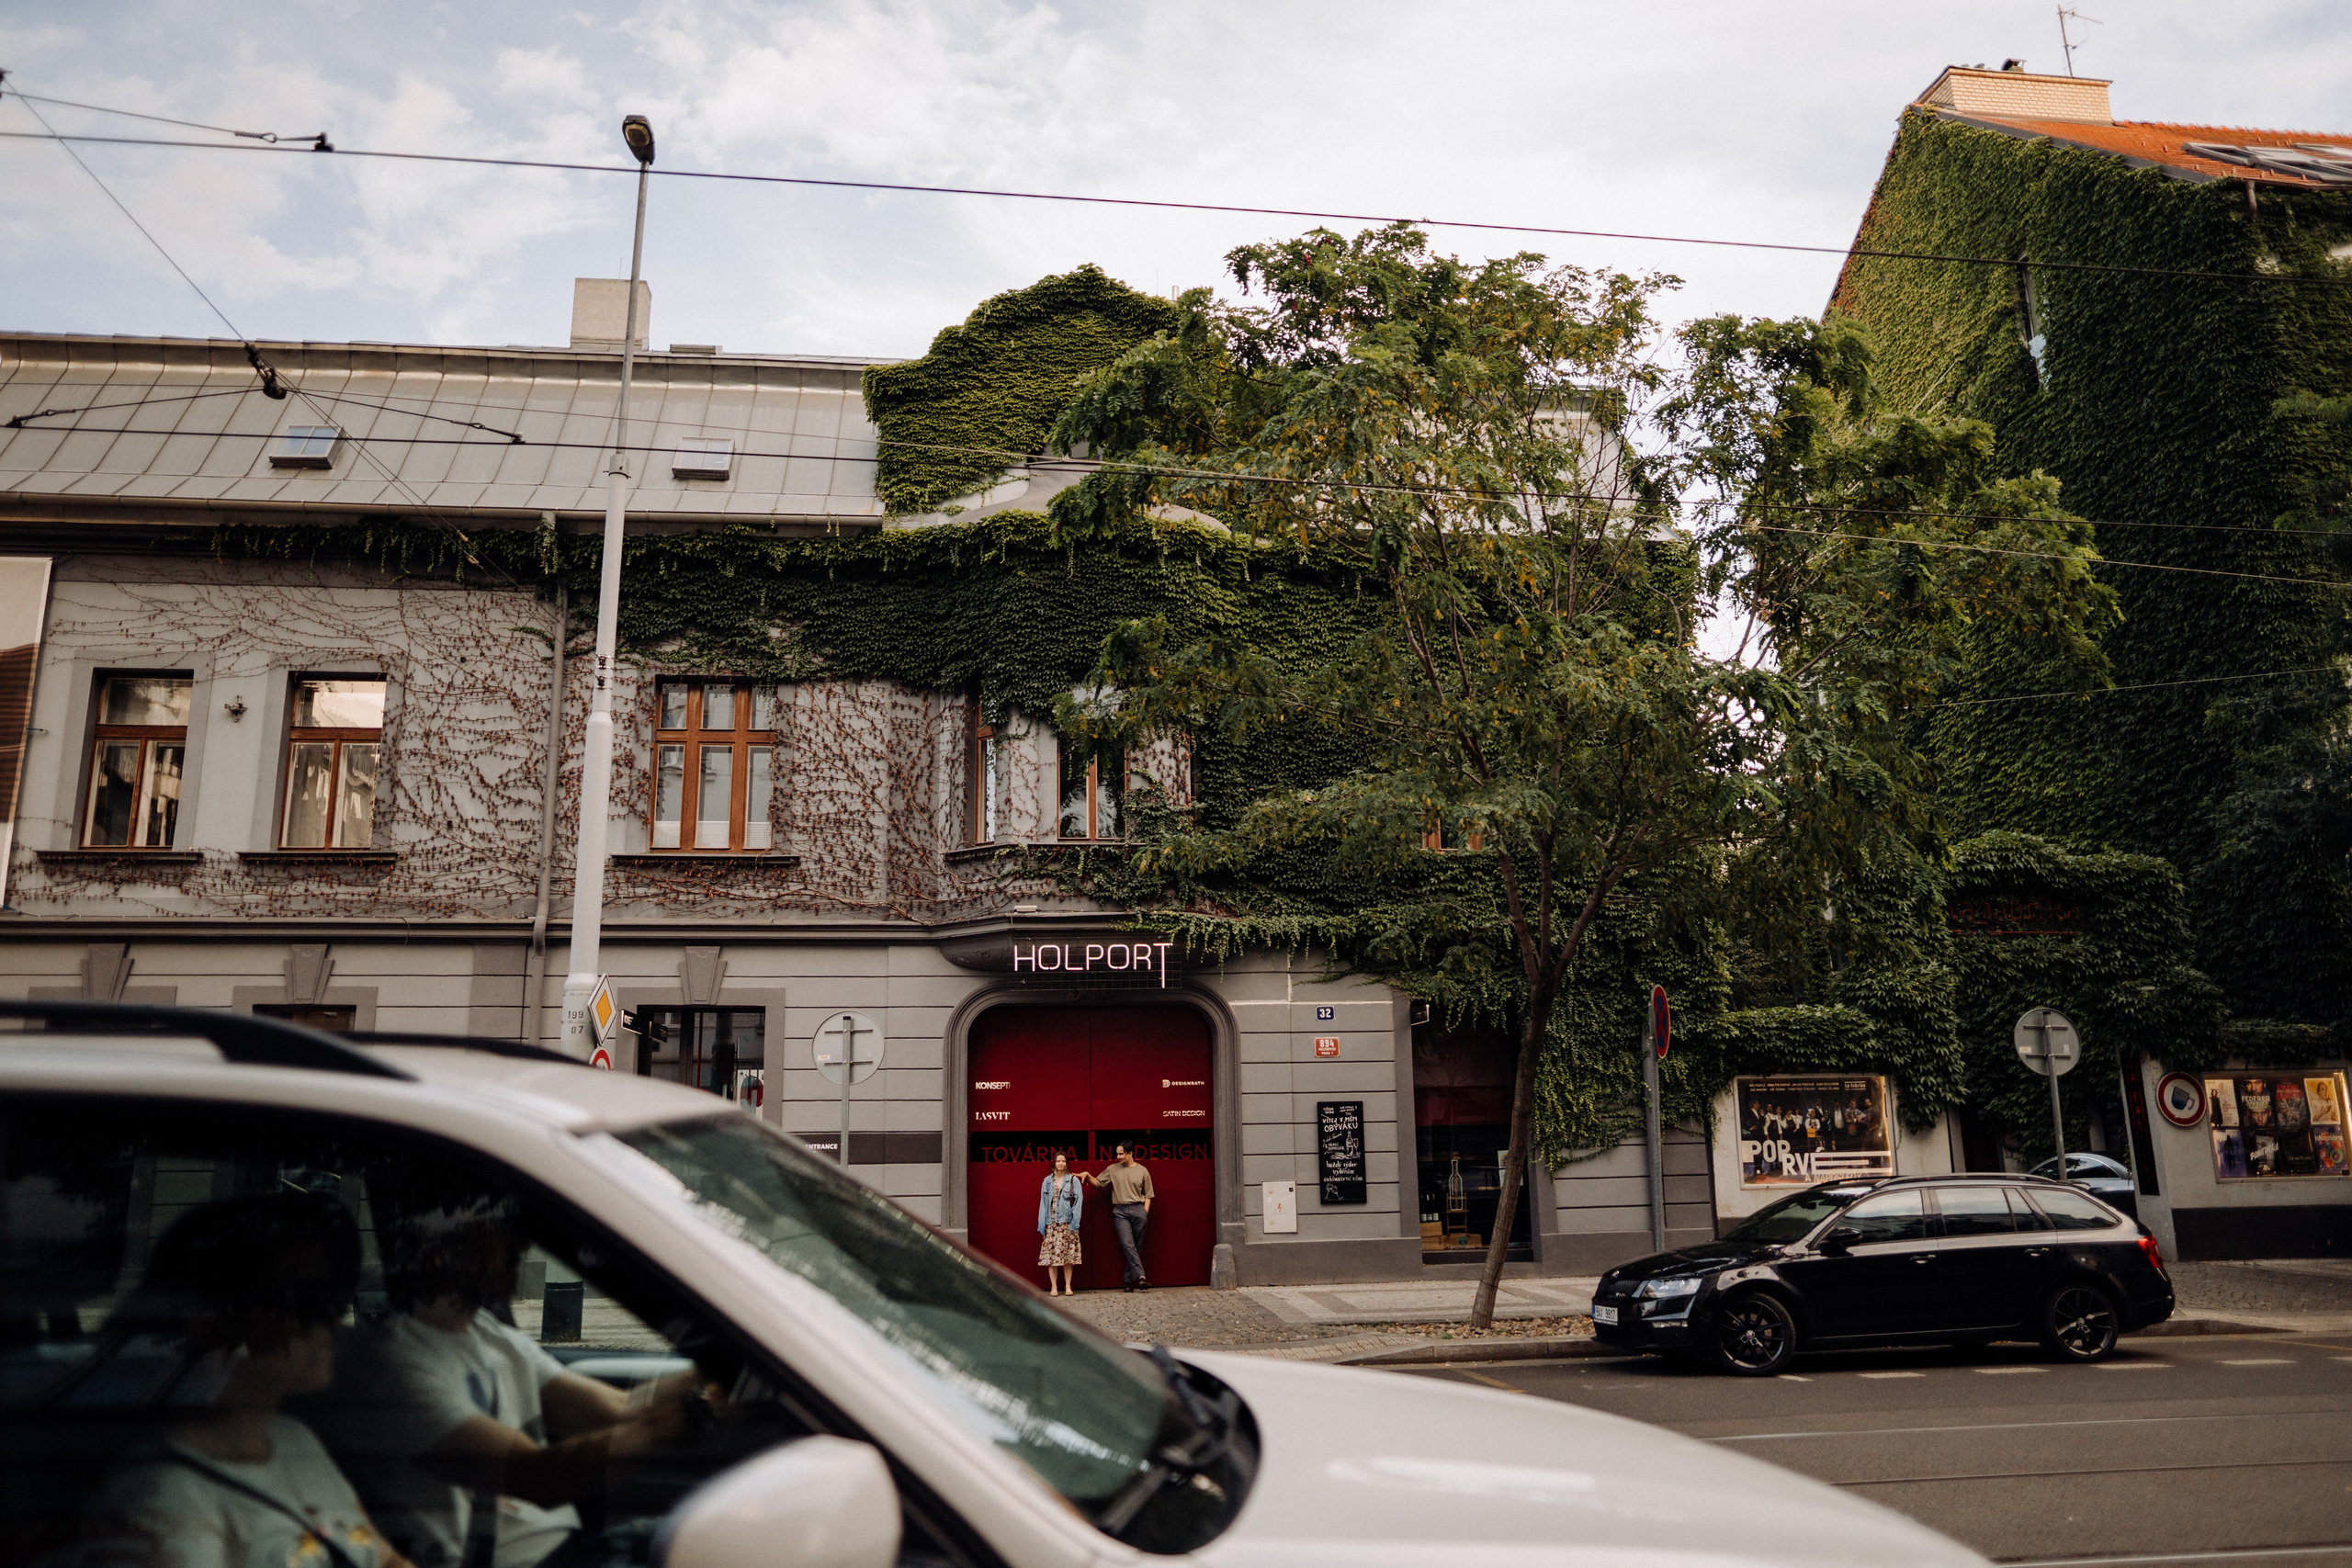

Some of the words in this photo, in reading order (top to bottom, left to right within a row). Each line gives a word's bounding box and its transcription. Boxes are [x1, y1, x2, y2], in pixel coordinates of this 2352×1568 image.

[1013, 942, 1173, 988] HOLPORT
[568, 1010, 584, 1020] 199
[1319, 1008, 1332, 1018] 32
[571, 1025, 584, 1034] 07
[1319, 1039, 1335, 1048] 894
[975, 1111, 1011, 1121] LASVIT
[1134, 1143, 1208, 1161] DESIGN
